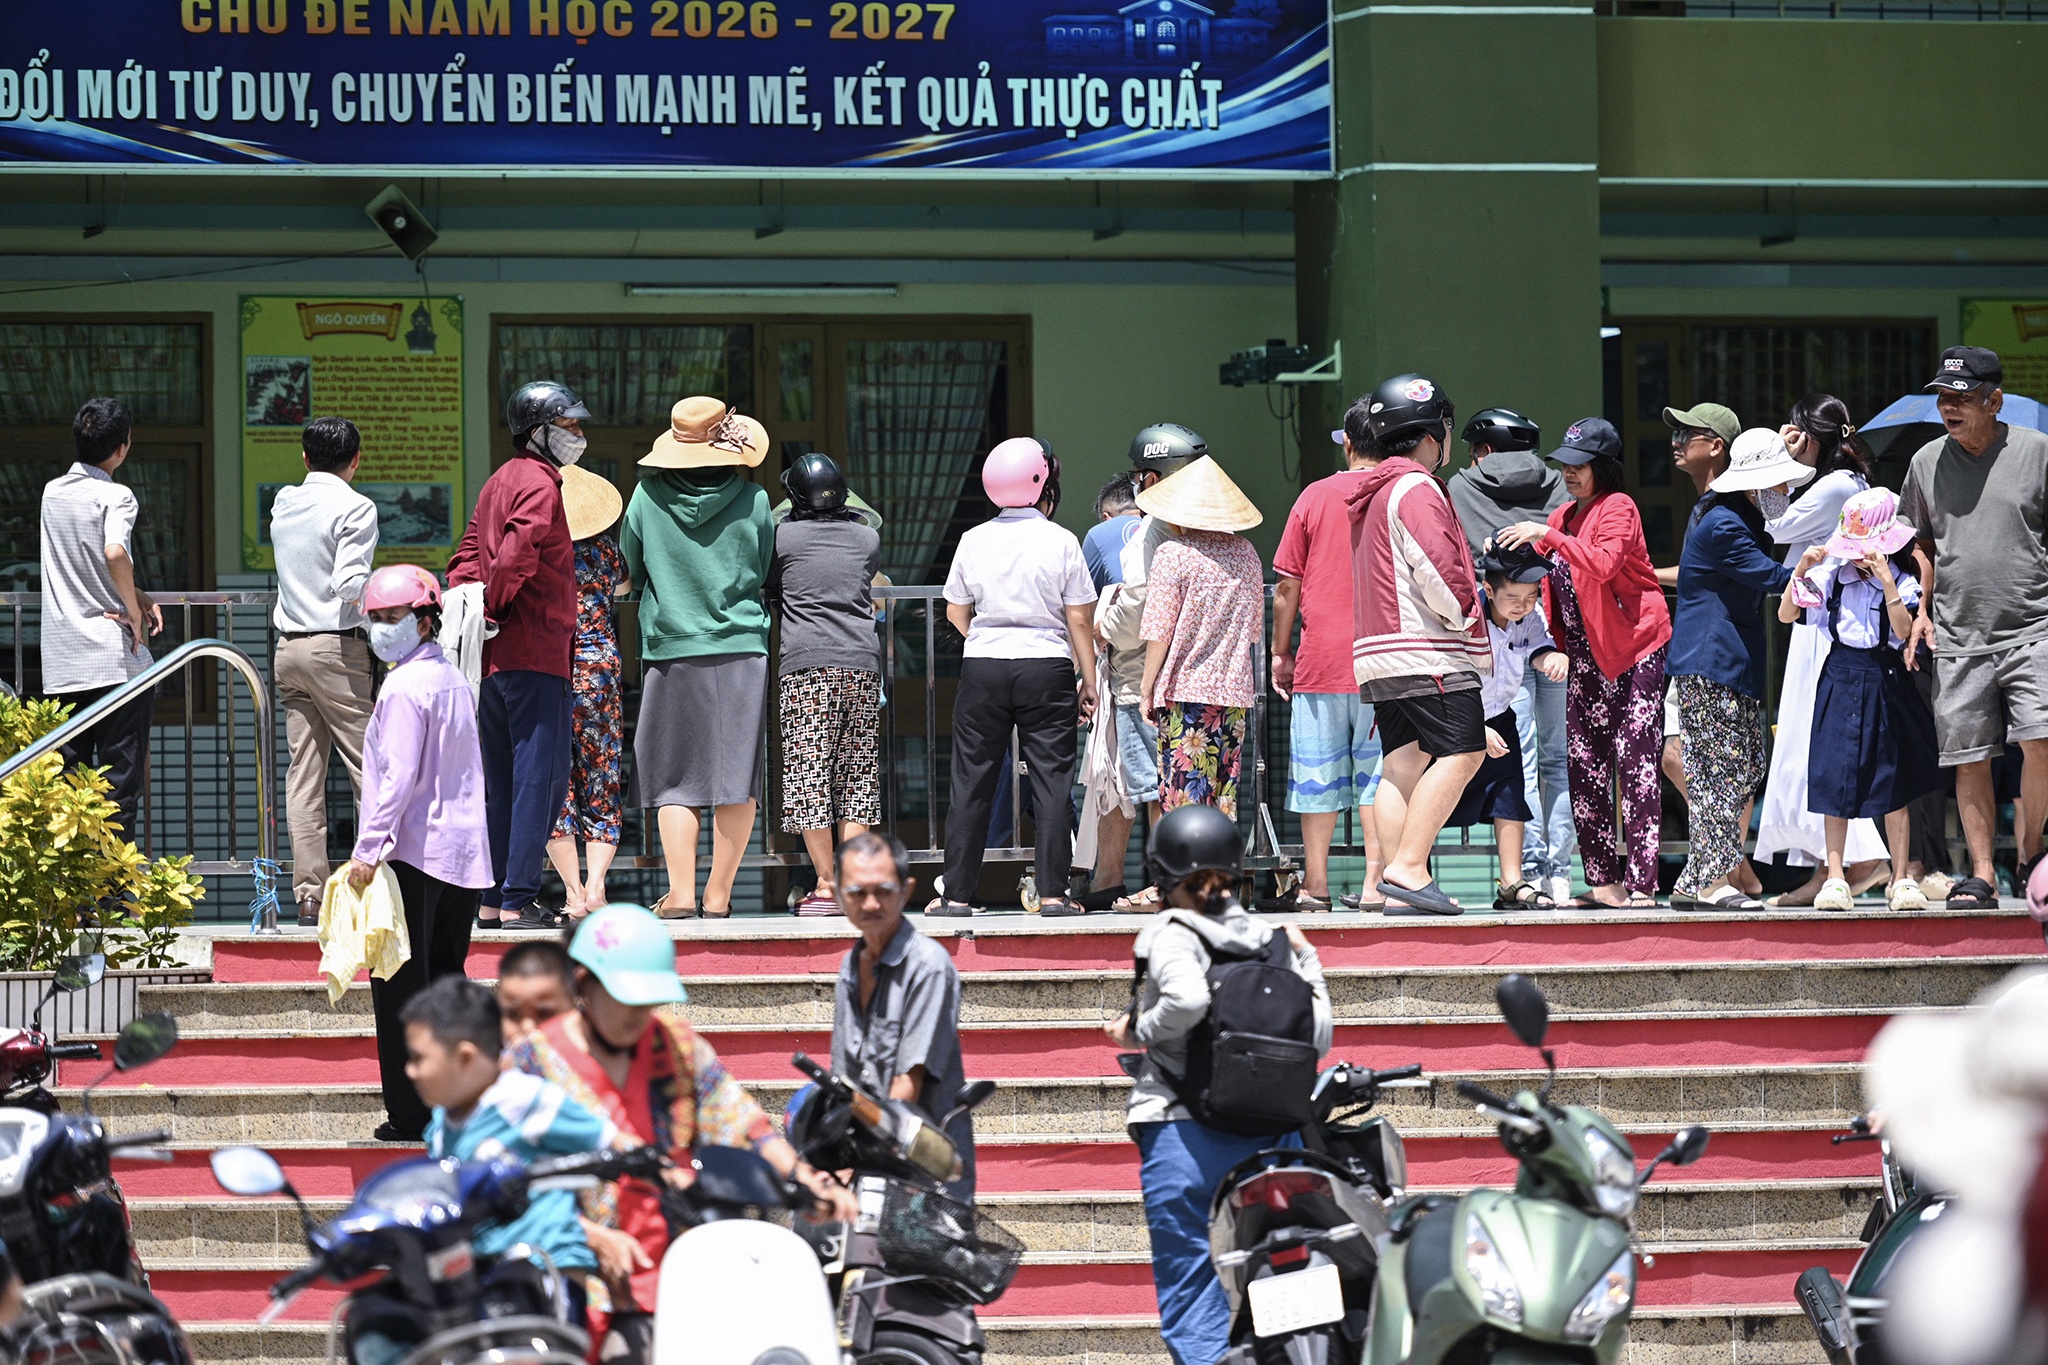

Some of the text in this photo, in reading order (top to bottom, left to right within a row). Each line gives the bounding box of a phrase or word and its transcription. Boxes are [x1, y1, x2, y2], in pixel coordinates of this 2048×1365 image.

[530, 0, 633, 44] HỌC
[650, 1, 778, 38] 2026
[830, 3, 955, 39] 2027
[0, 48, 1223, 138] ĐỔI MỚI TƯ DUY, CHUYỂN BIẾN MẠNH MẼ, KẾT QUẢ THỰC CHẤT
[315, 311, 342, 325] NGÔ
